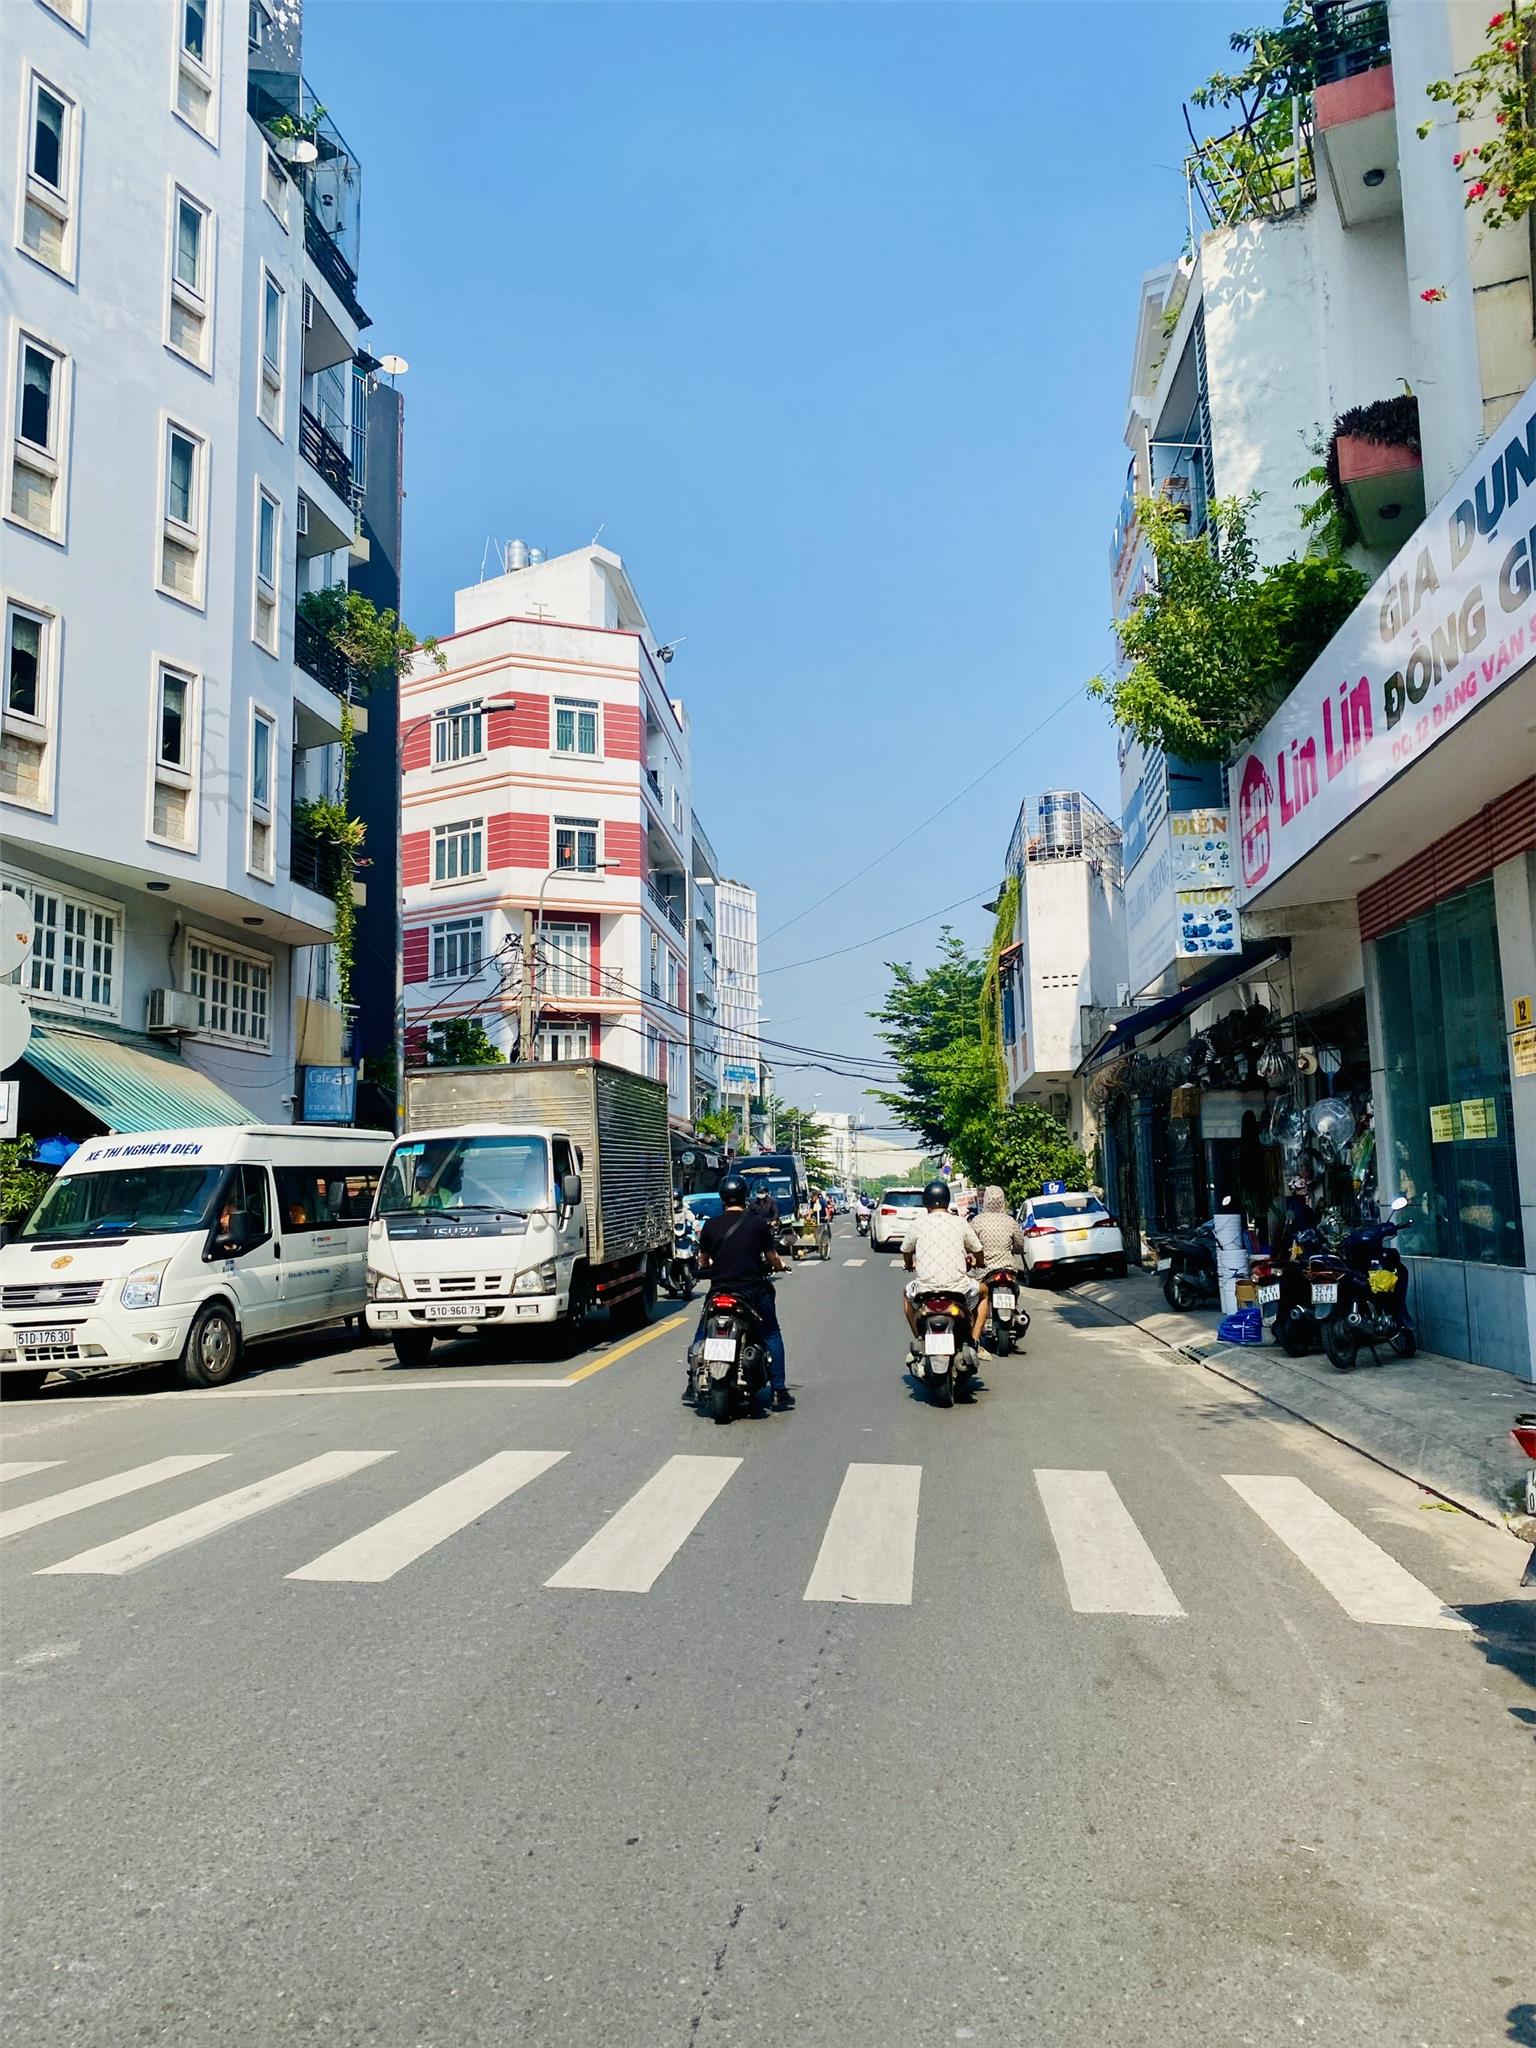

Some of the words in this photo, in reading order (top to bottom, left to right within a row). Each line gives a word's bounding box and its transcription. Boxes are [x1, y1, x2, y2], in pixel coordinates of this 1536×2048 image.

[1380, 545, 1440, 642] GIA
[1384, 585, 1487, 731] ĐỒNG
[1415, 715, 1429, 743] 12
[1277, 736, 1319, 827] Lin
[1322, 676, 1374, 783] Lin
[1518, 1000, 1526, 1020] 12
[85, 1151, 100, 1162] XE
[124, 1142, 170, 1156] NGHIỆM
[433, 1226, 479, 1236] ISUZU
